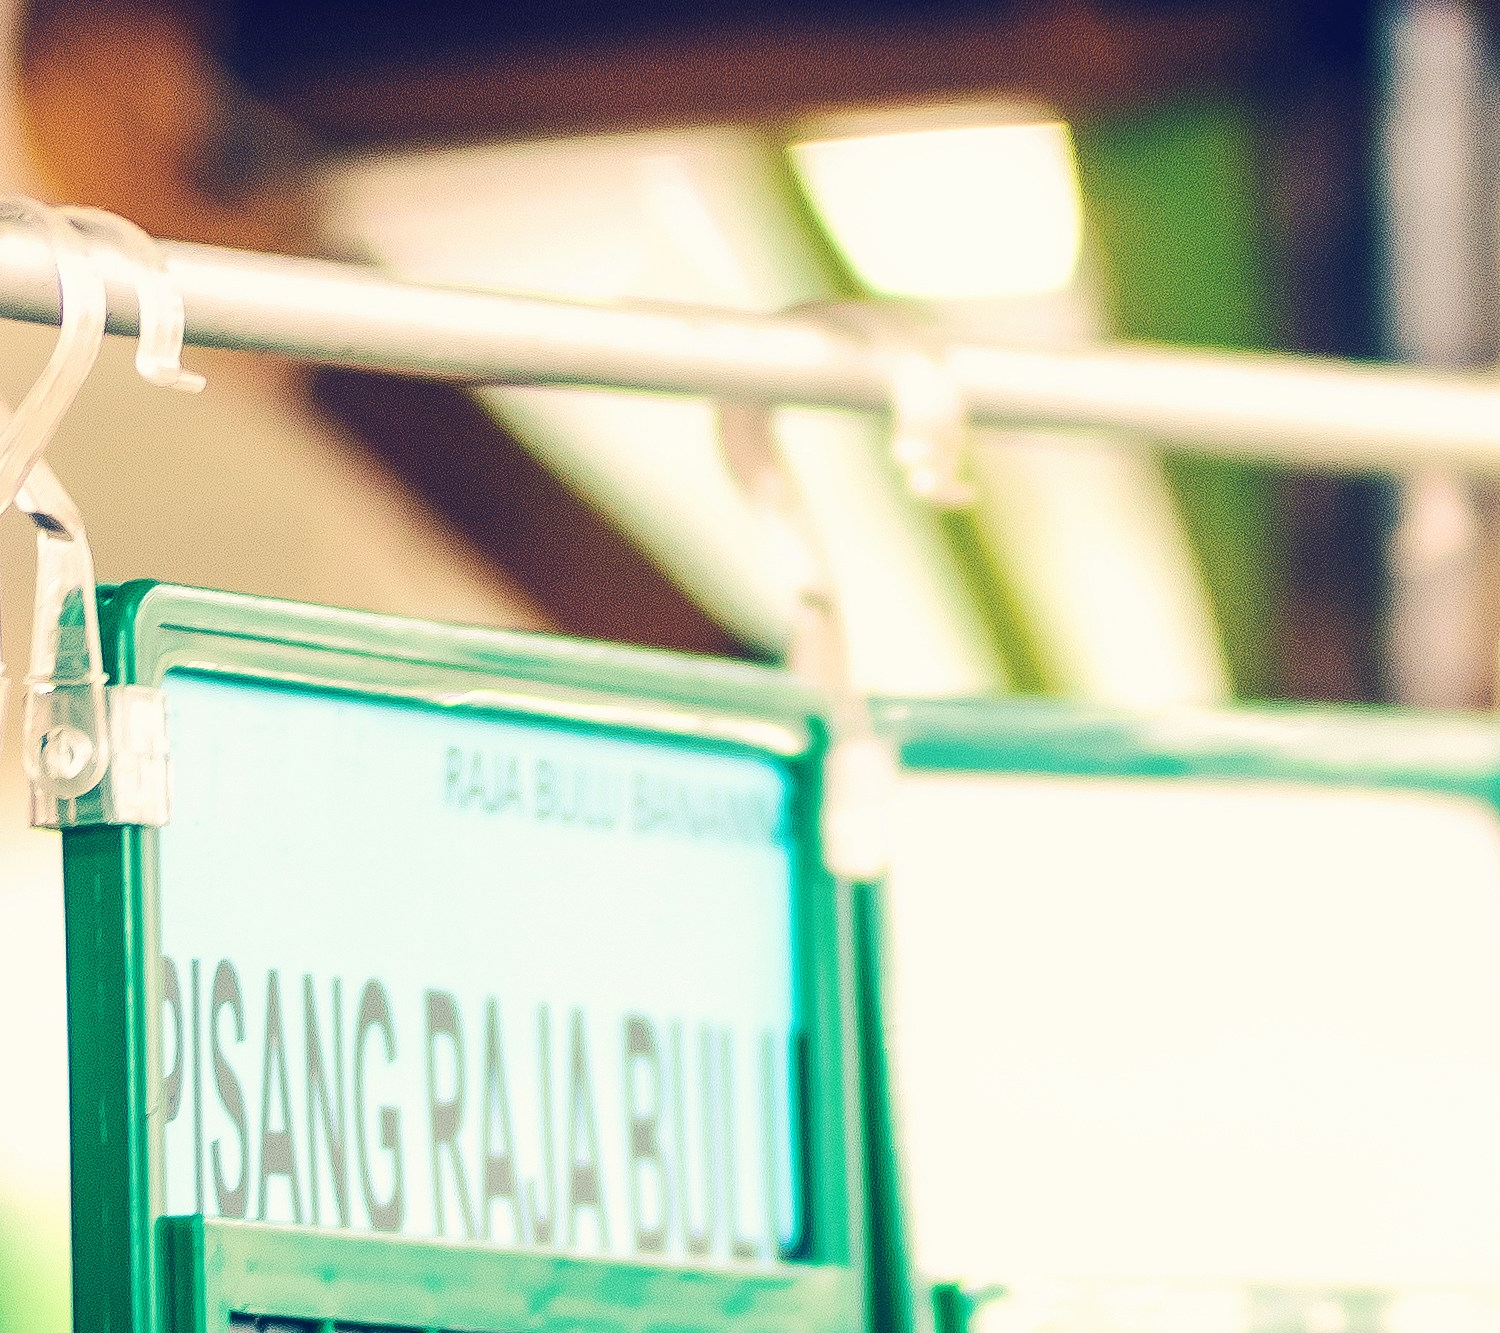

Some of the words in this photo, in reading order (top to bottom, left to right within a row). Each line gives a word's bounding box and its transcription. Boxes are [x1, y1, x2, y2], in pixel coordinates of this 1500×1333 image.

[444, 744, 525, 815] RAJA
[160, 954, 404, 1232] PISANG
[422, 986, 609, 1254] RAJA
